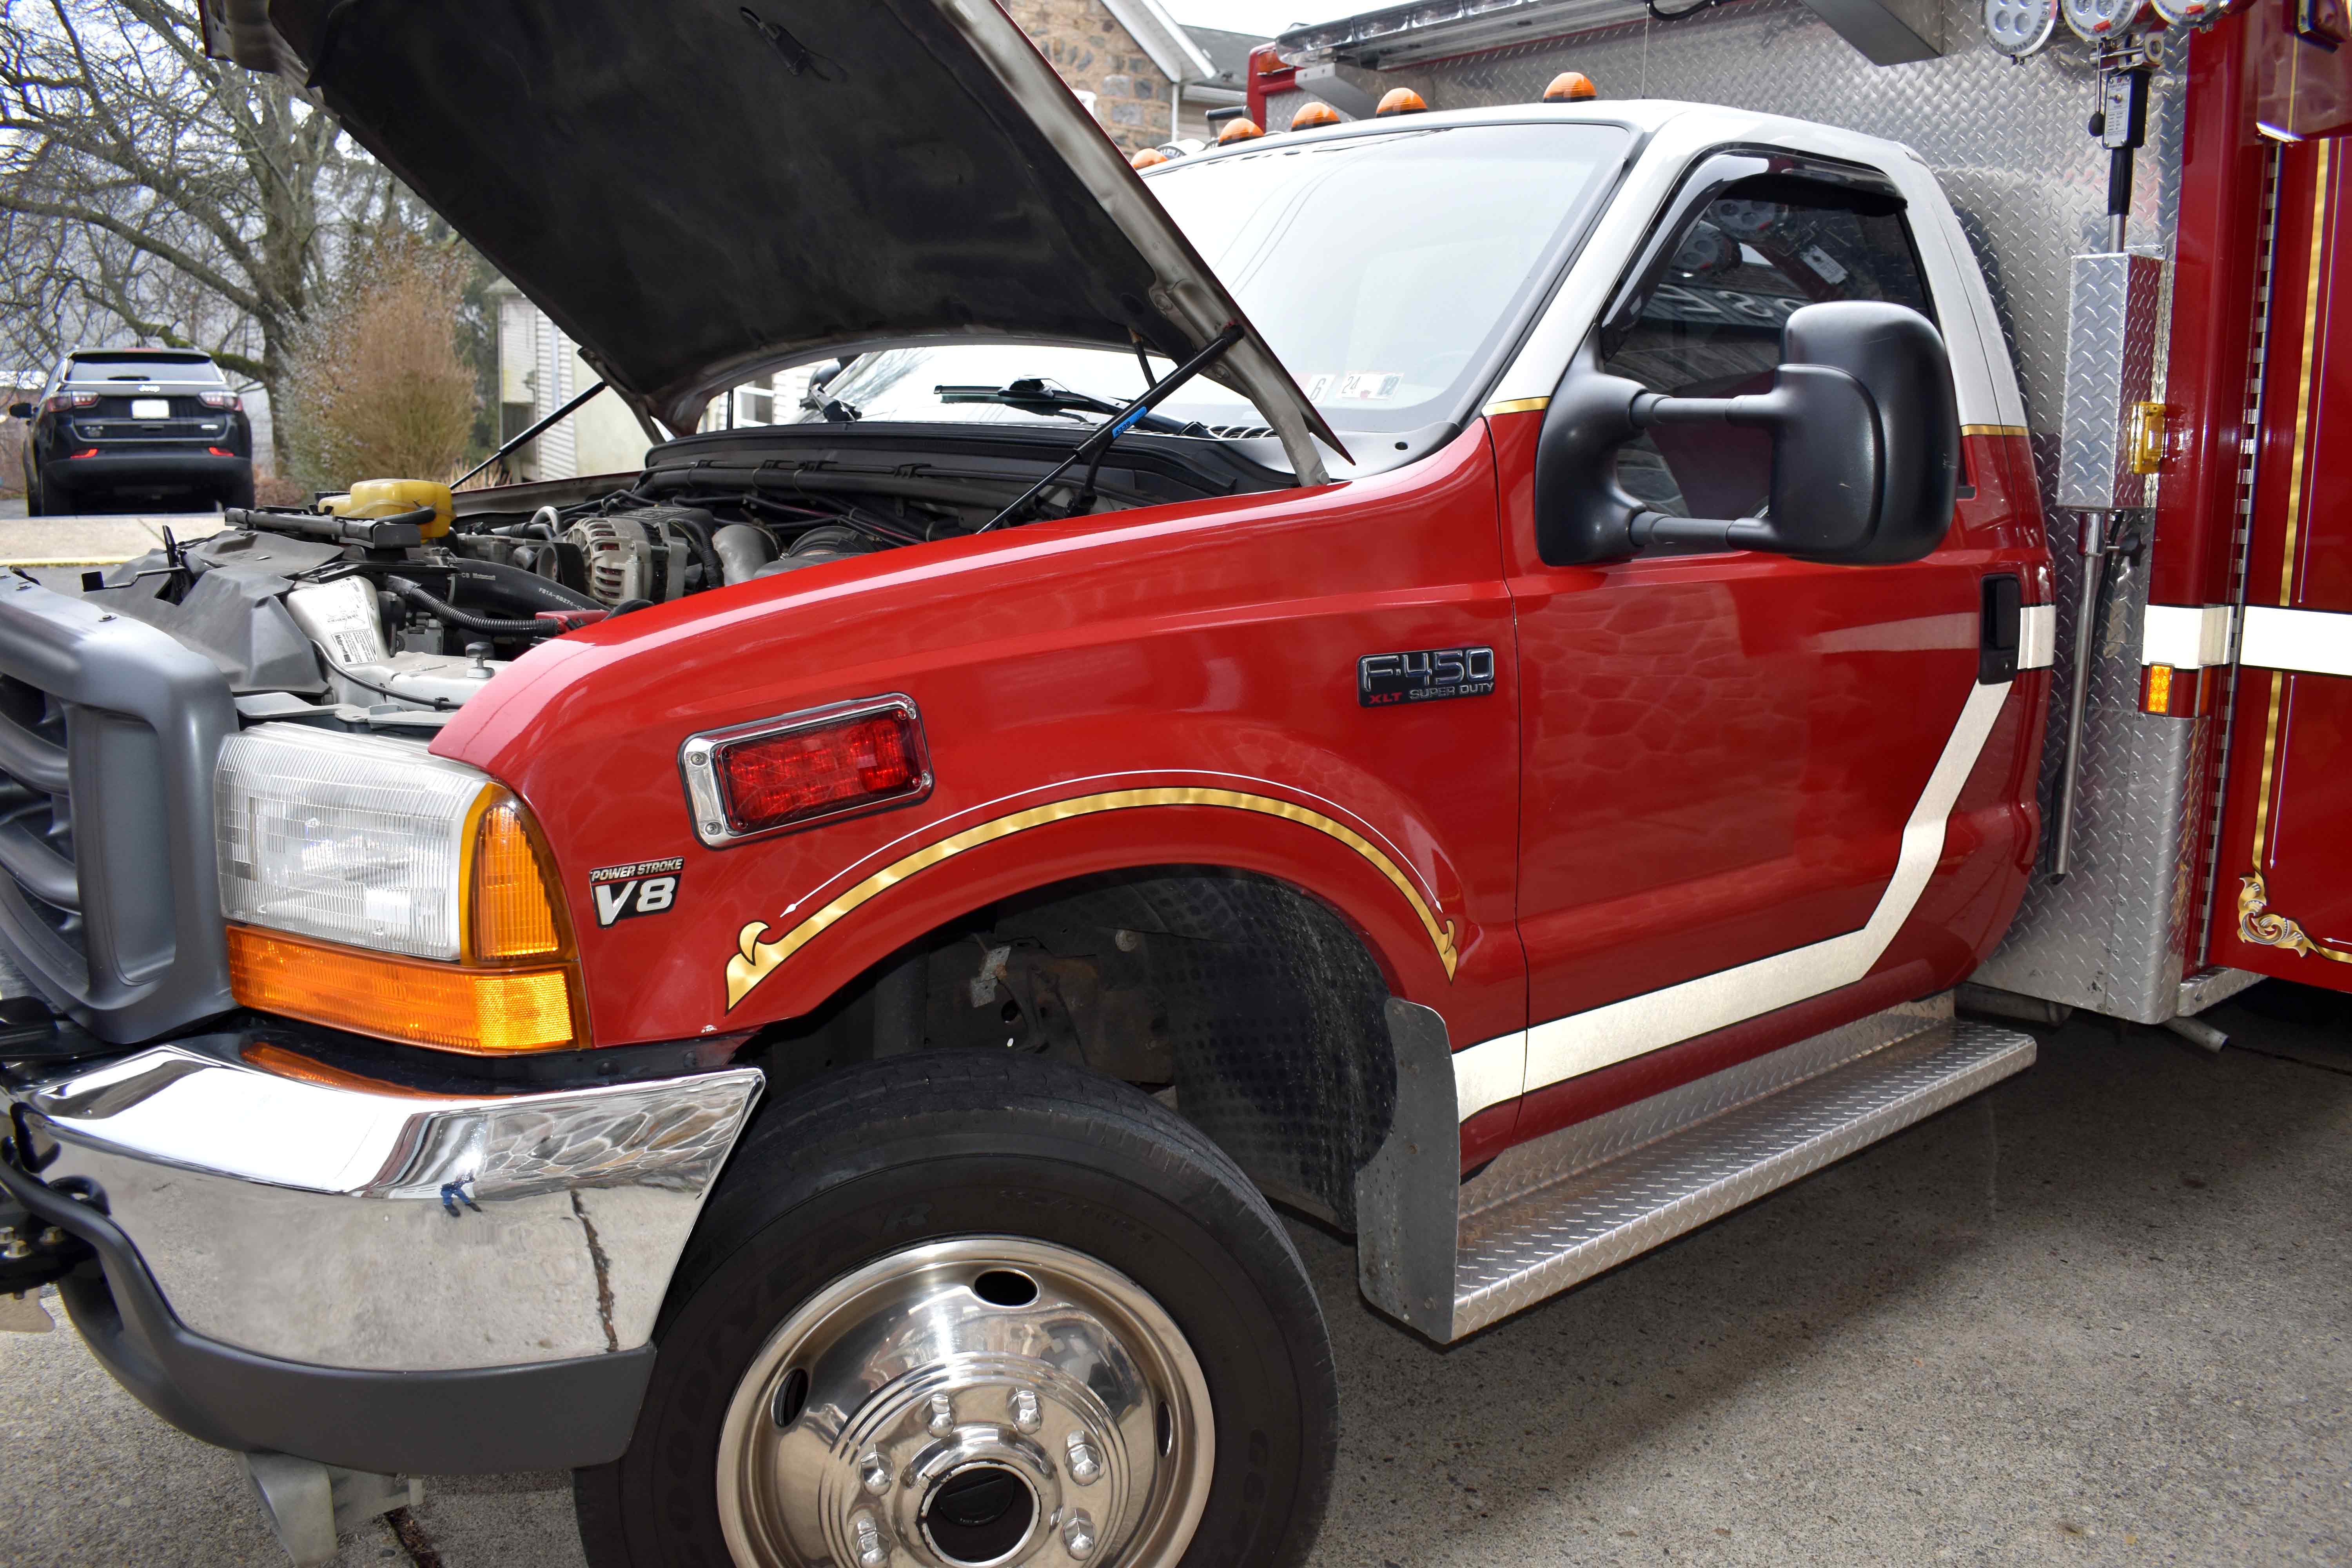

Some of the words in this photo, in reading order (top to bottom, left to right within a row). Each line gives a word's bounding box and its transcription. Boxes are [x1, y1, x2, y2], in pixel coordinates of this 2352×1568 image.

[1309, 377, 1327, 401] 6
[1362, 648, 1494, 691] F-450
[1368, 692, 1403, 704] XLT
[1409, 686, 1455, 700] SUPER
[1459, 682, 1494, 695] DUTY
[592, 865, 635, 882] POWER
[637, 858, 683, 875] STROKE
[595, 877, 676, 925] V8
